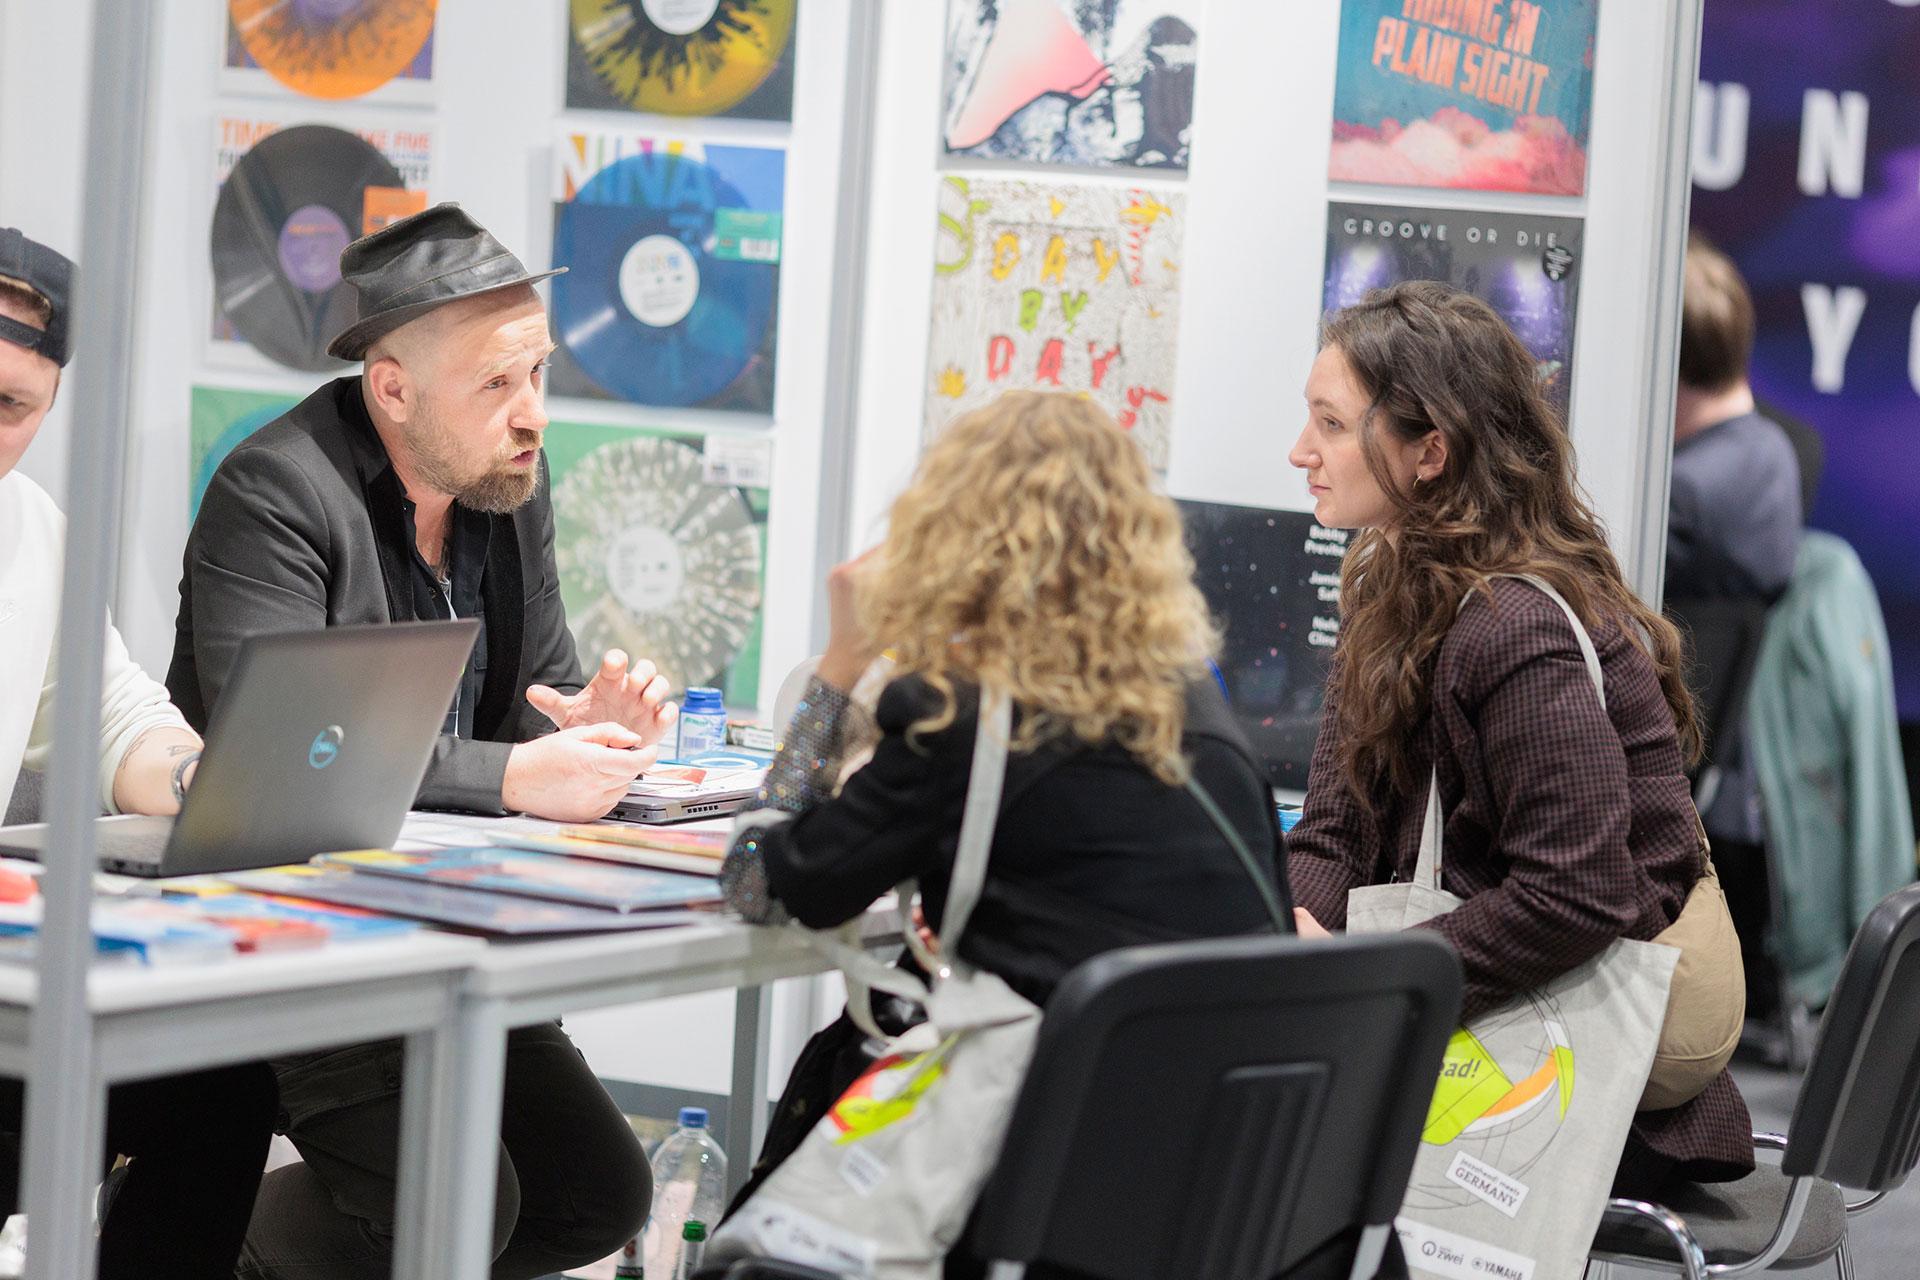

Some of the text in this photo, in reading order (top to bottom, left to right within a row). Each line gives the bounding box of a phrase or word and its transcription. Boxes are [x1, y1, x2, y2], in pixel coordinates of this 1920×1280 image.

[1502, 0, 1541, 55] IN
[1372, 16, 1550, 115] PLAIN SIGHT
[990, 230, 1120, 284] DAY
[1344, 217, 1557, 249] GROOVE OR DIE
[986, 335, 1122, 389] DAY
[1801, 281, 1920, 397] Y
[1440, 1058, 1481, 1078] ad!
[1456, 1167, 1518, 1207] GERMANY
[1484, 1260, 1523, 1280] YAMAHA
